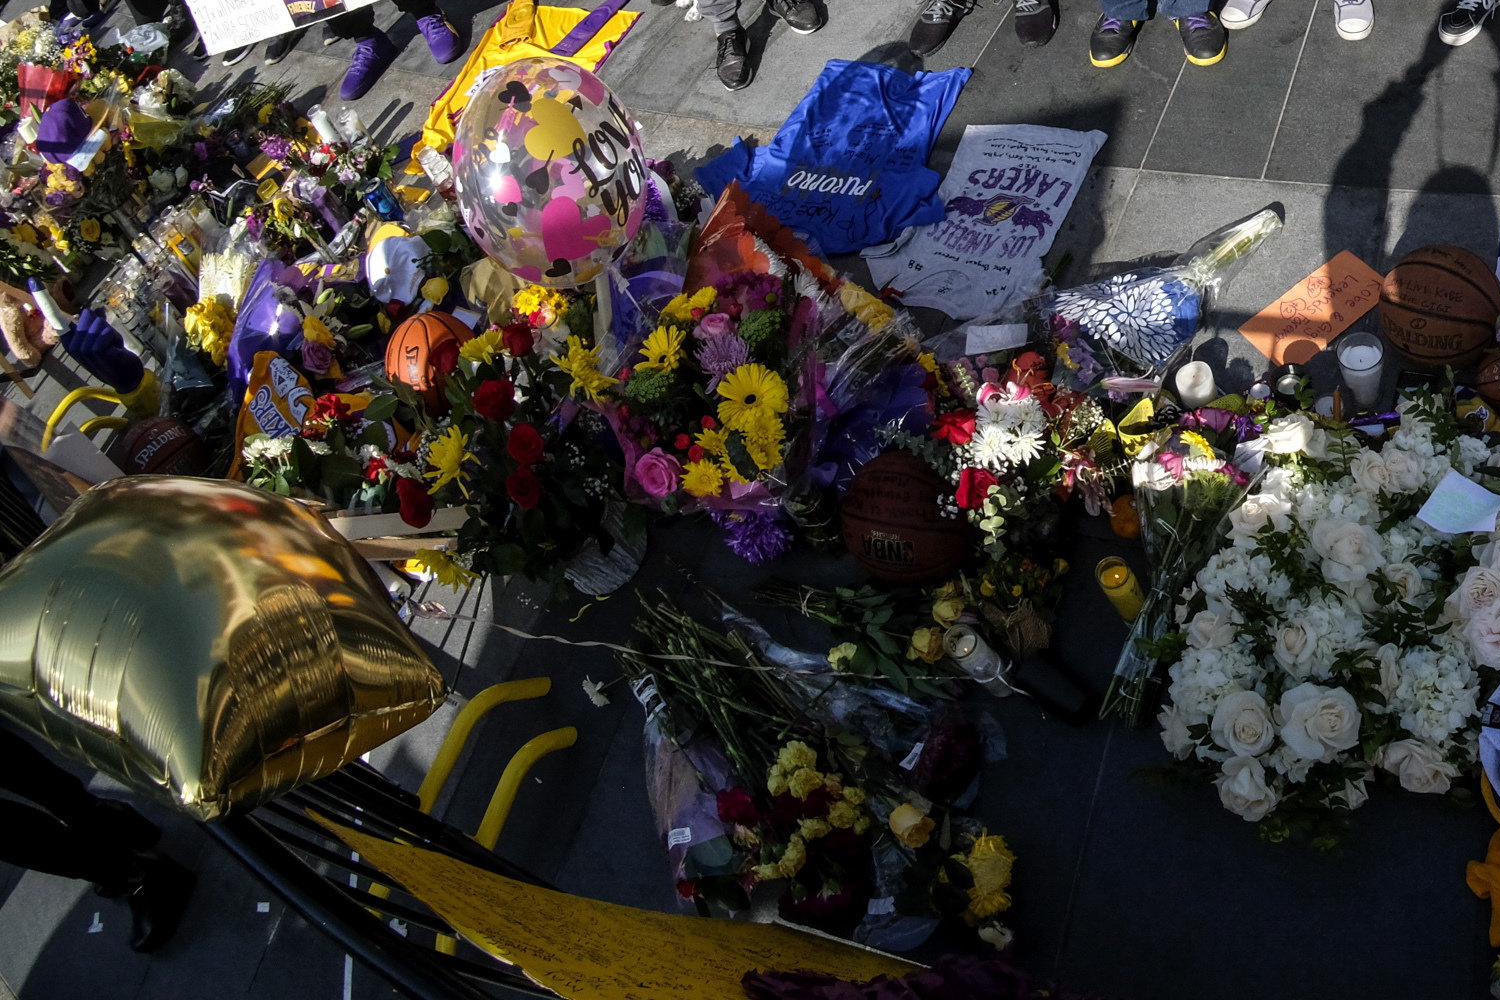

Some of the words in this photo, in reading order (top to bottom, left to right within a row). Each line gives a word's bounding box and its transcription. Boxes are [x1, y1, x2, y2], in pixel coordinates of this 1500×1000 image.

[788, 170, 873, 196] PUROPRO
[968, 166, 1073, 208] LAKERS
[927, 218, 999, 258] ANGELES
[1001, 234, 1039, 260] LOS
[1307, 274, 1359, 315] Legends
[1345, 279, 1381, 308] Kobe
[134, 425, 186, 470] SPALDING
[860, 534, 901, 561] NBA
